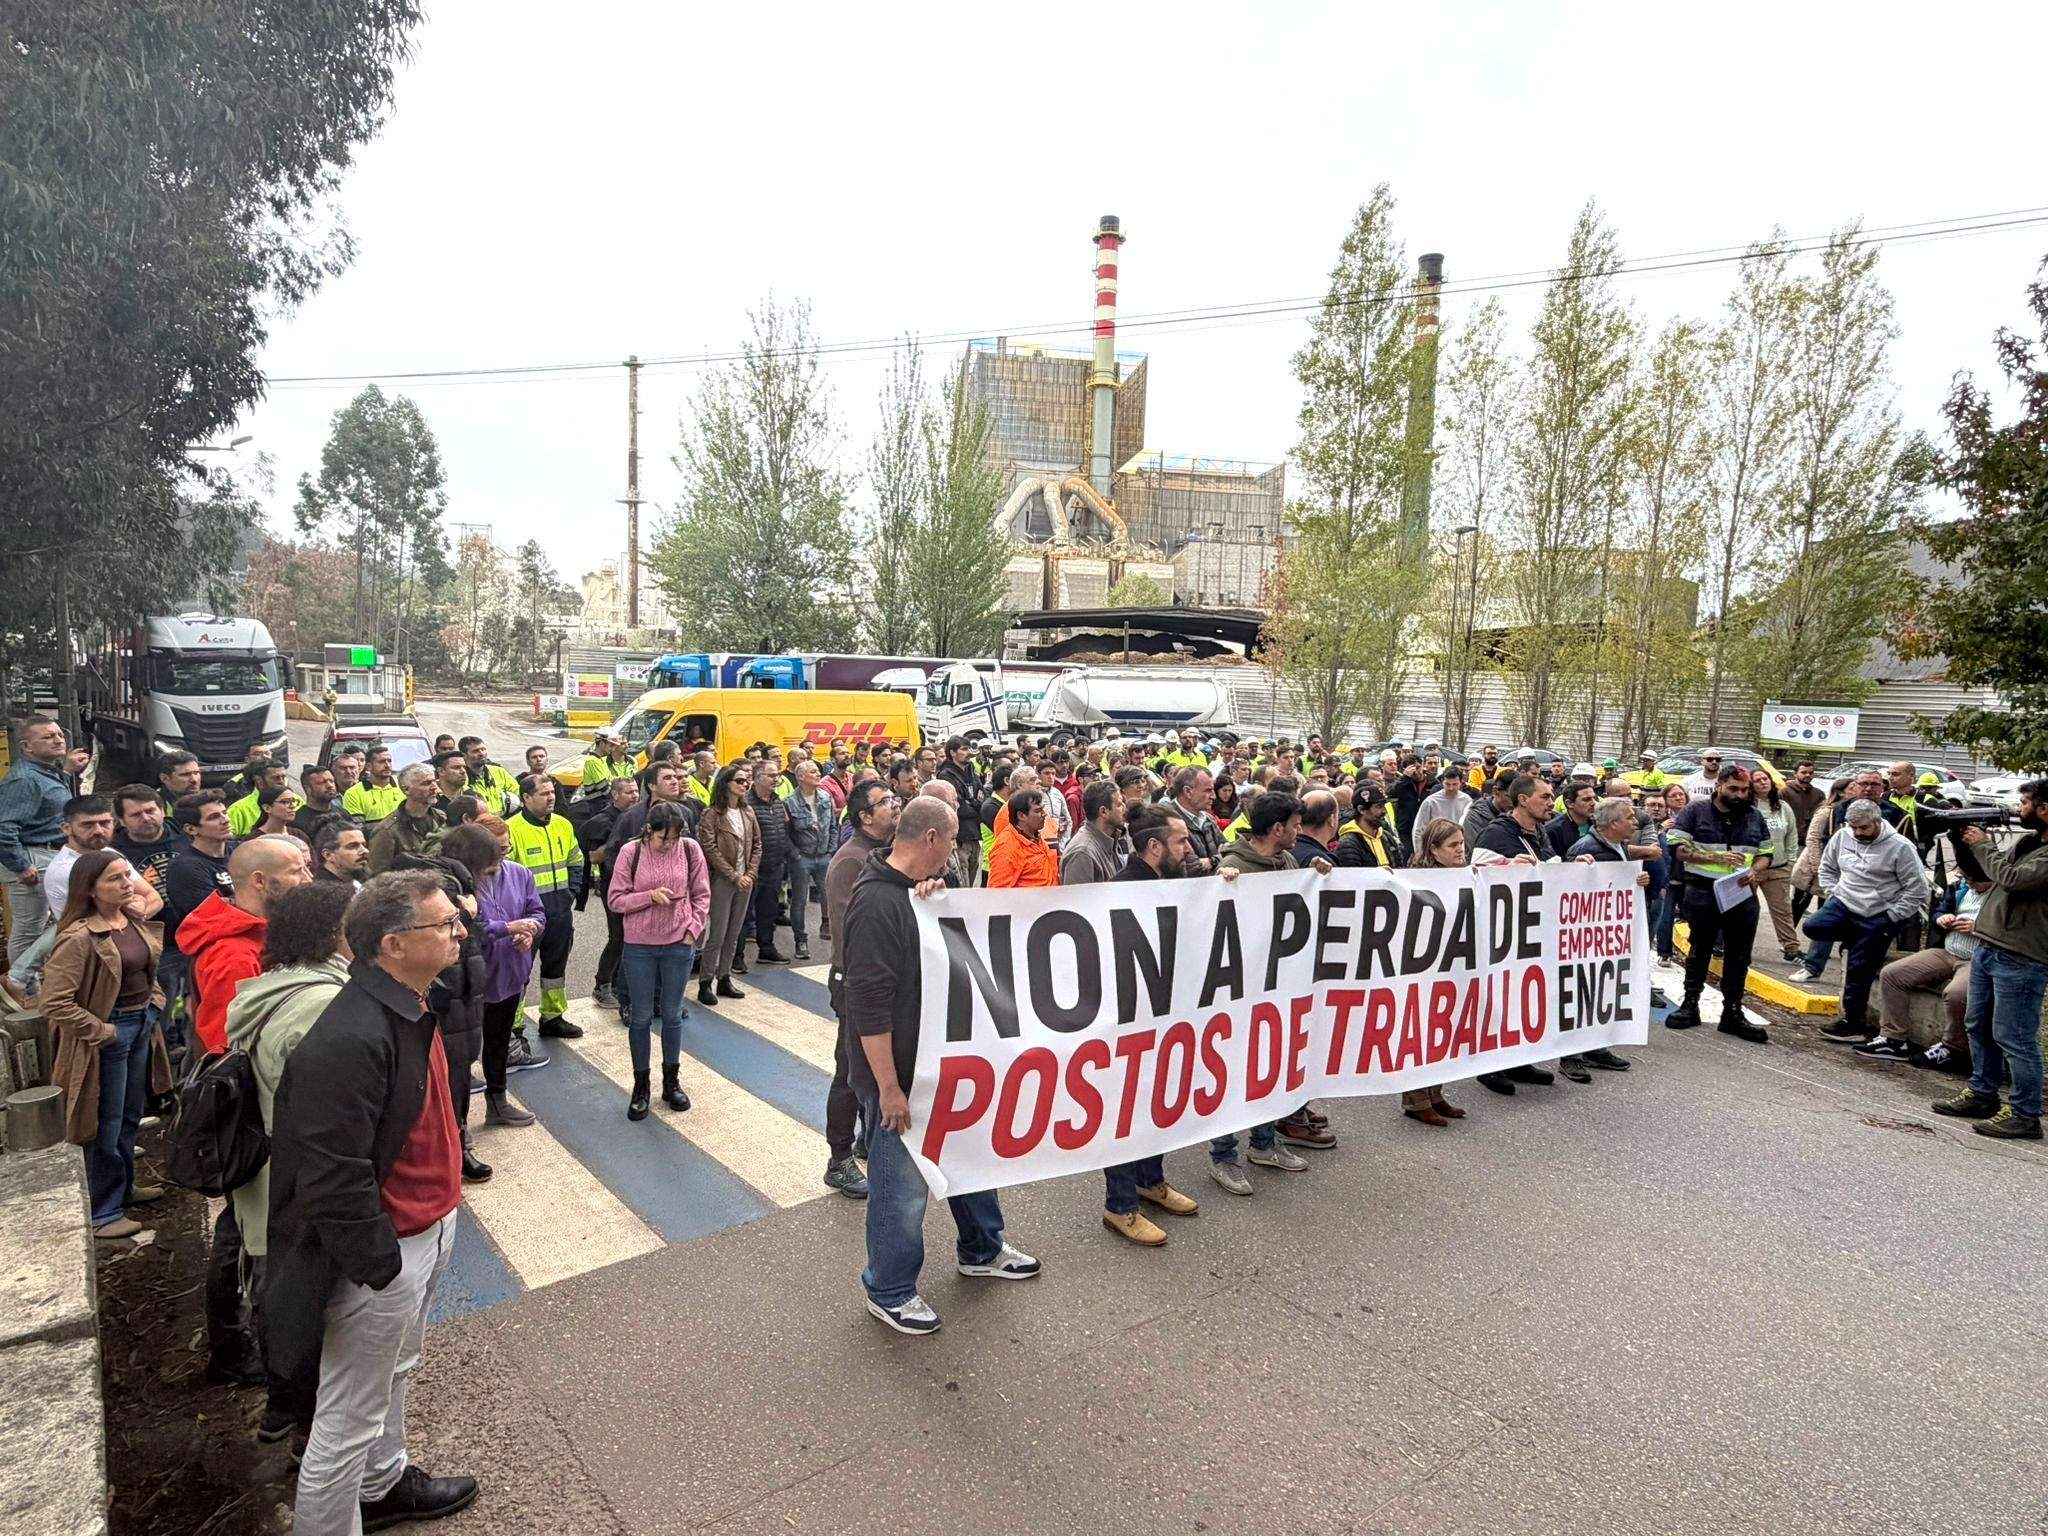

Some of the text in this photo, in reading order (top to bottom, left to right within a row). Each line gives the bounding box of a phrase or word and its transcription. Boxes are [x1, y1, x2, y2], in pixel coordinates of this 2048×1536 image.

[202, 704, 241, 712] IVECO
[803, 722, 892, 745] DHL
[1559, 882, 1633, 925] COMITÉ DE
[938, 881, 1543, 1043] NON A PERDA DE
[1558, 924, 1632, 961] EMPRESA
[1558, 958, 1633, 1032] ENCE
[921, 964, 1547, 1167] POSTOS DE TRABALLO
